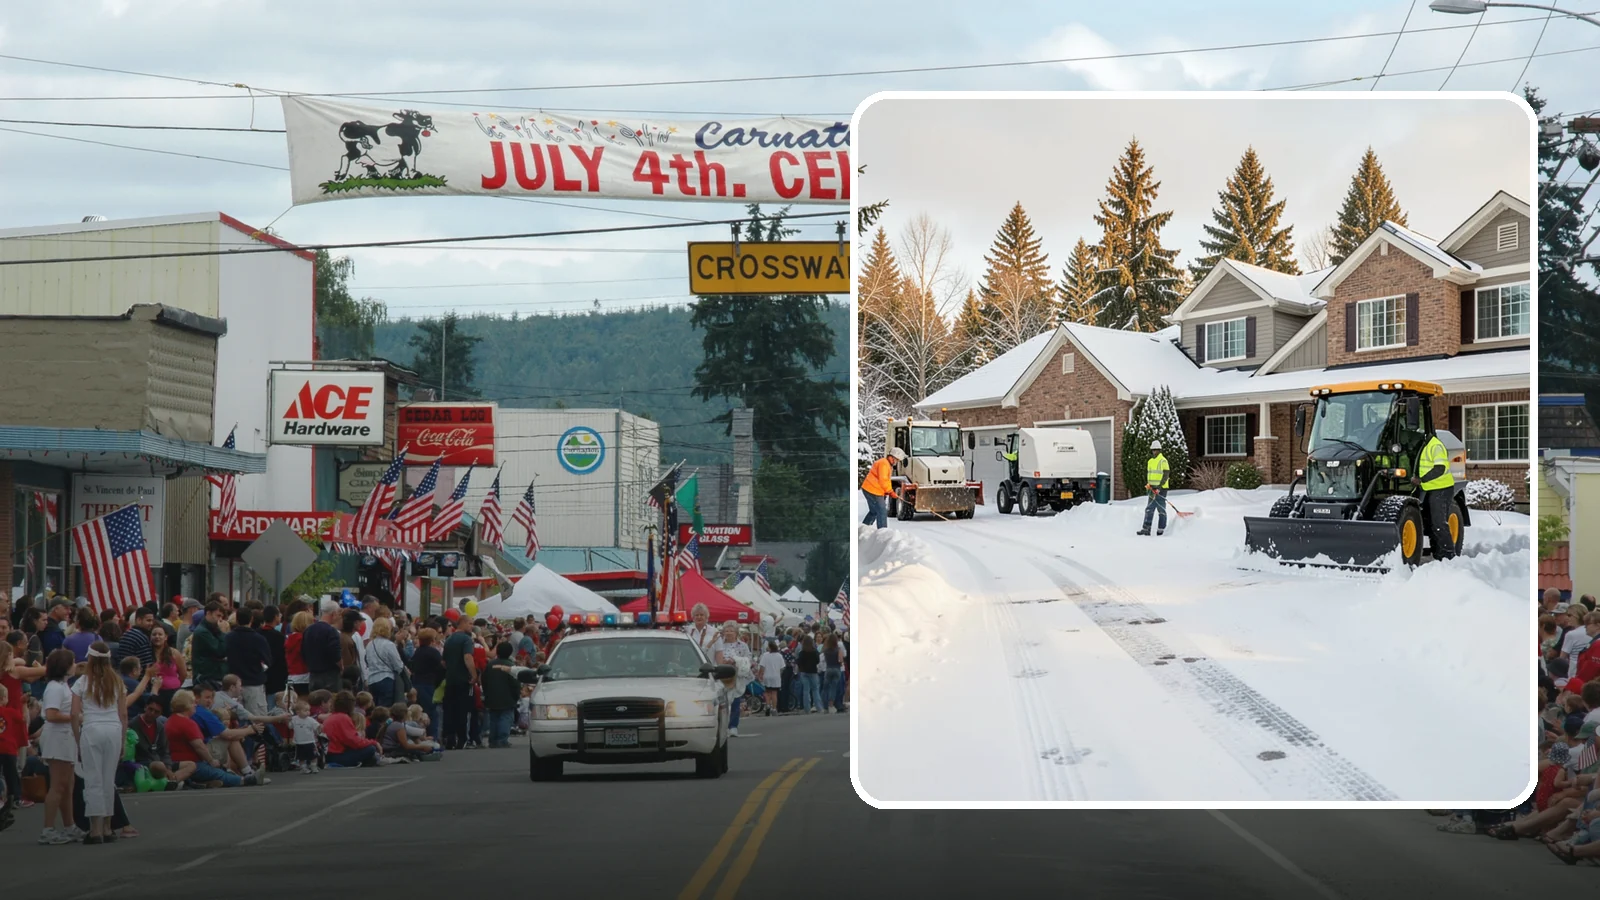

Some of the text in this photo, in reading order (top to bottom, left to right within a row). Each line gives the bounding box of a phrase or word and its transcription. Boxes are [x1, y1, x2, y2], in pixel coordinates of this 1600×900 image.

[695, 121, 850, 149] Carnat
[481, 141, 605, 192] JULY
[632, 150, 746, 198] 4th.
[696, 254, 850, 280] CROSSWA
[282, 379, 373, 419] ACE
[405, 409, 485, 422] CEDAR LOG
[283, 421, 370, 436] Hardware
[416, 428, 477, 447] Coca-Cola
[83, 485, 155, 495] St. Vincent de Paul
[81, 503, 153, 522] THT
[688, 526, 741, 535] CRNATION
[699, 535, 730, 543] GLASS
